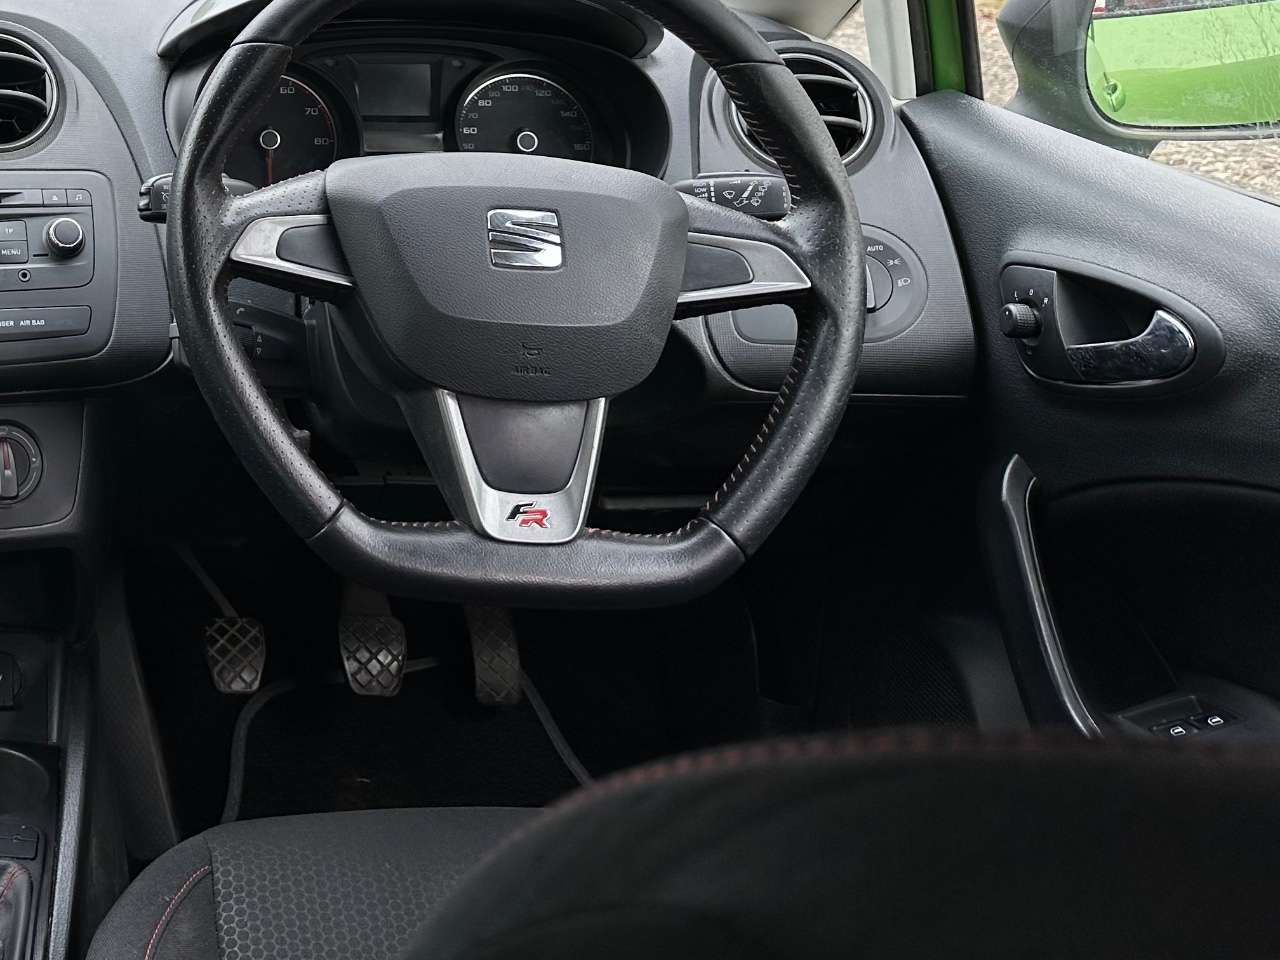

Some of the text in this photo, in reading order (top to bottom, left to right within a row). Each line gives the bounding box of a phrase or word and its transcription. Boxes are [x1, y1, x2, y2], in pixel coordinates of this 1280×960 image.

[502, 84, 519, 93] 100
[478, 99, 492, 107] 80
[463, 126, 478, 134] 60
[1, 248, 21, 256] MENU
[866, 244, 884, 252] AUTO
[505, 502, 550, 528] FR
